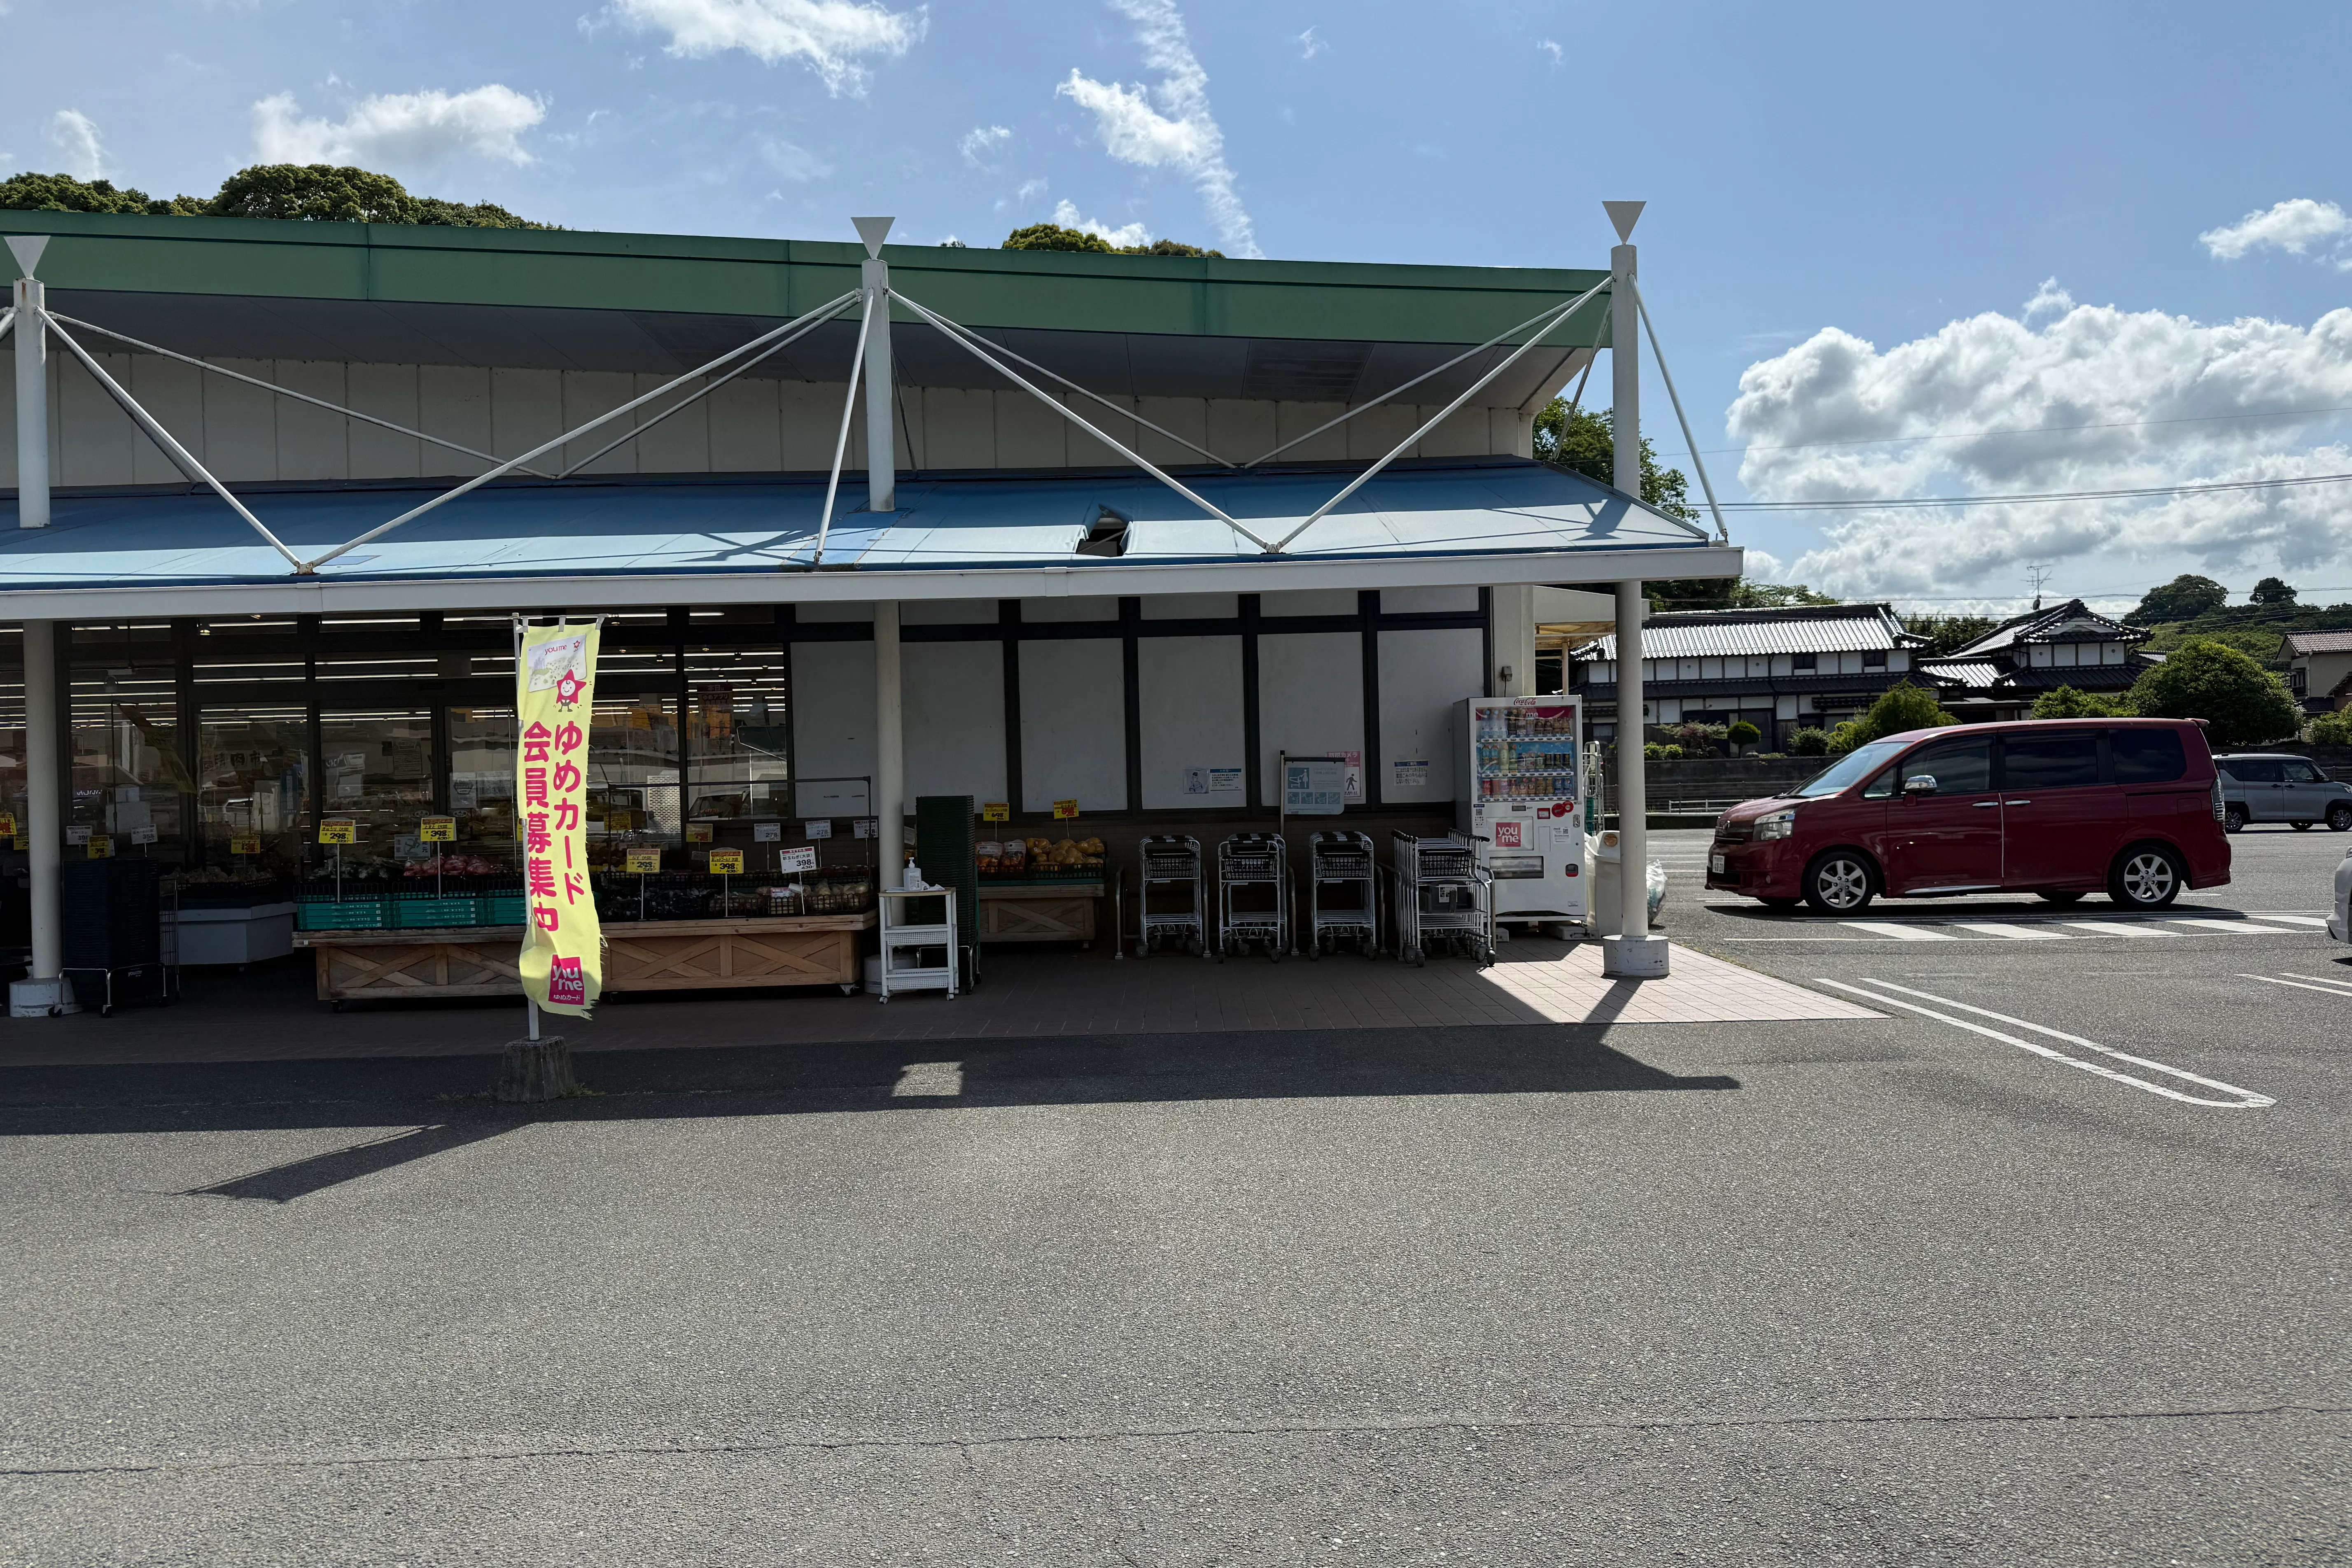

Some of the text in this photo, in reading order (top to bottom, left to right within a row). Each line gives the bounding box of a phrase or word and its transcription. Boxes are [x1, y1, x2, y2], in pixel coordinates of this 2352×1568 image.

[545, 645, 567, 656] youme
[524, 721, 559, 932] 会員募集中
[553, 721, 585, 905] ゆめカード
[1498, 827, 1518, 837] you
